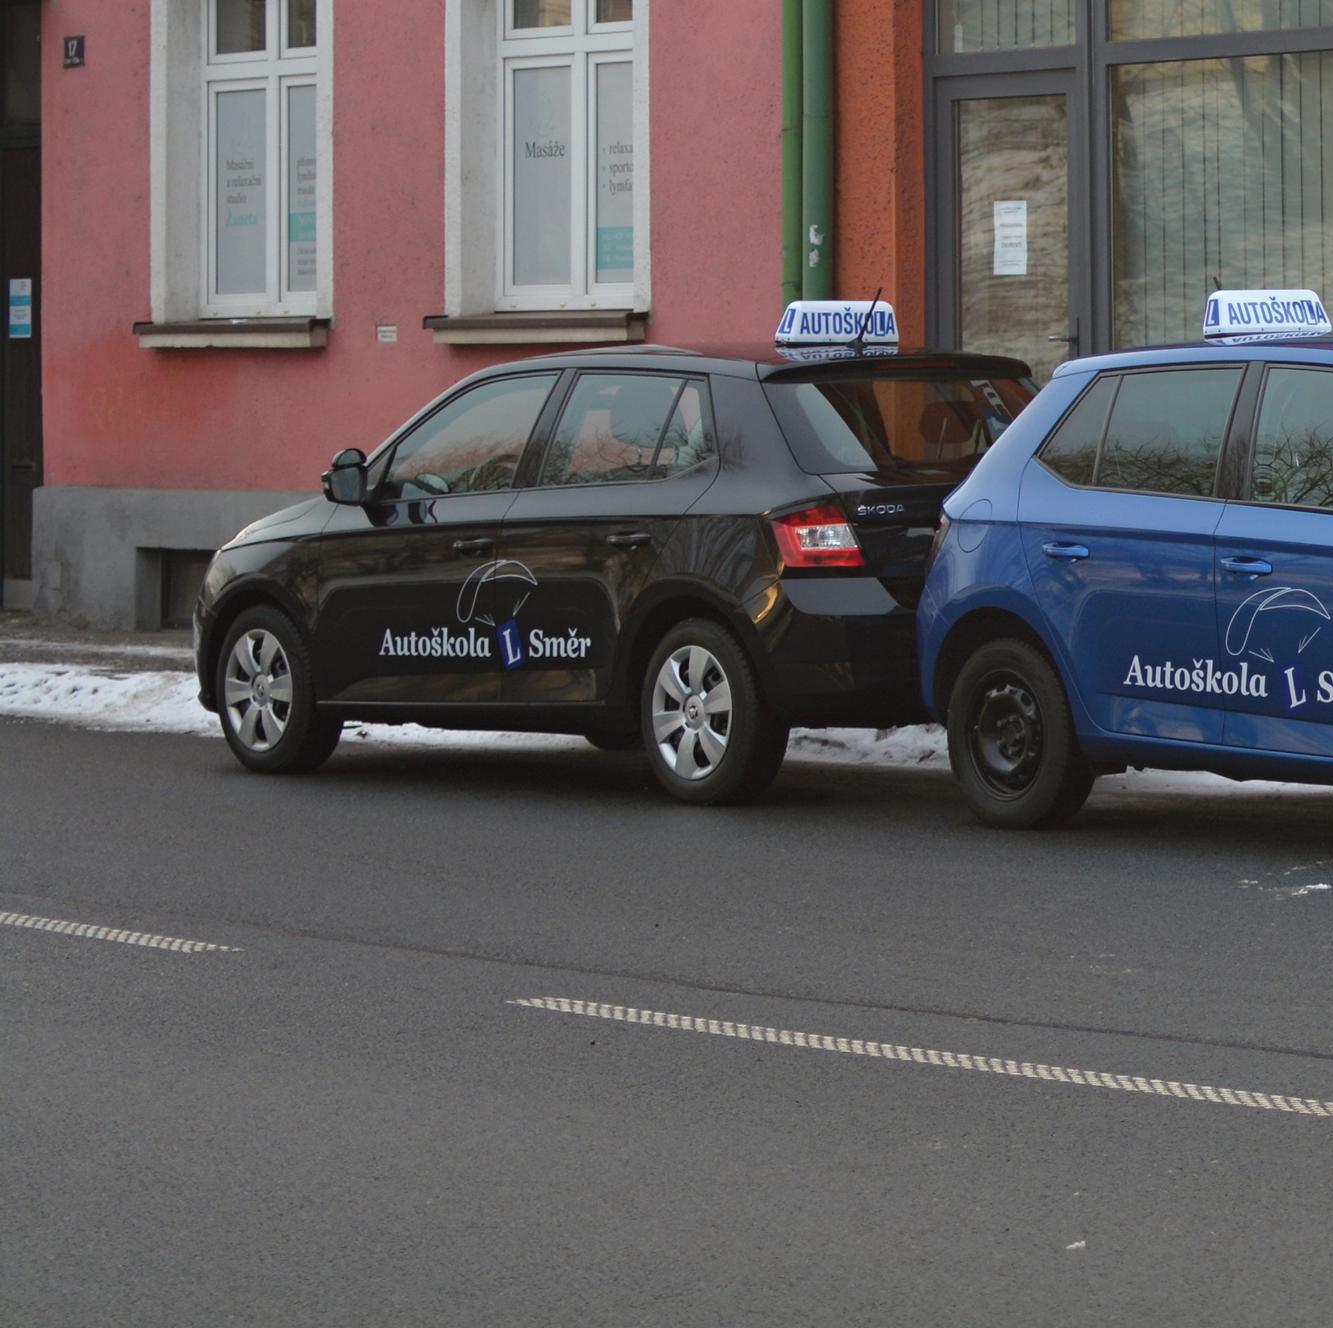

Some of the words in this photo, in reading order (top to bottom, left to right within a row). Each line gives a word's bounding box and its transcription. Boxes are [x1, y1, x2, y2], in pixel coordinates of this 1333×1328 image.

[525, 141, 566, 158] Masáže
[800, 307, 895, 336] AUTOŠKOLA
[1228, 296, 1327, 325] AUTOŠKOLA
[857, 504, 904, 516] ŠKODA
[379, 627, 491, 658] Autoškola
[529, 628, 592, 658] Směr
[1123, 655, 1268, 697] Autoškola
